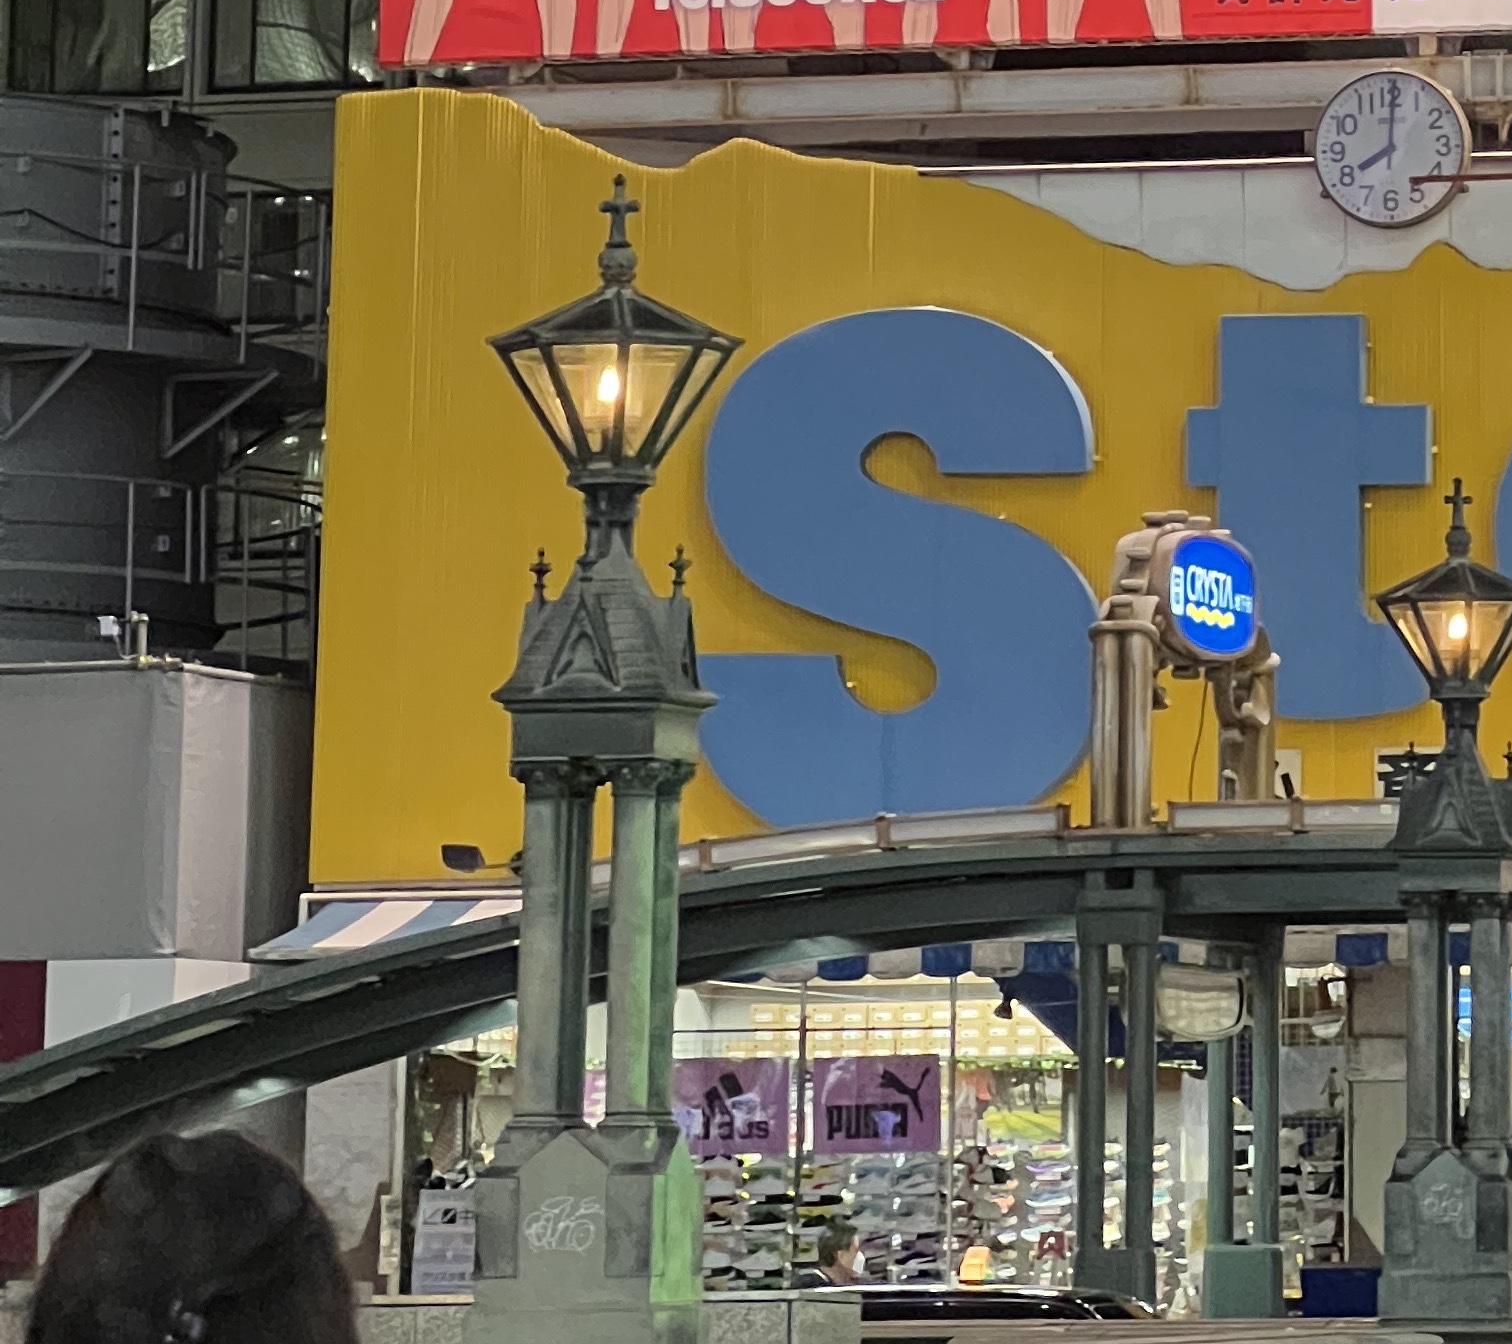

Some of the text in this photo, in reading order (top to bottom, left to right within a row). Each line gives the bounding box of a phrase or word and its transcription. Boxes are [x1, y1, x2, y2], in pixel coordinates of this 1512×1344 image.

[1357, 92, 1375, 116] 11
[1329, 113, 1358, 137] 10
[1428, 107, 1444, 130] 2
[1329, 141, 1346, 163] 9
[1435, 134, 1452, 157] 3
[1339, 164, 1356, 187] 8
[1358, 184, 1376, 207] 7
[1382, 189, 1400, 212] 6
